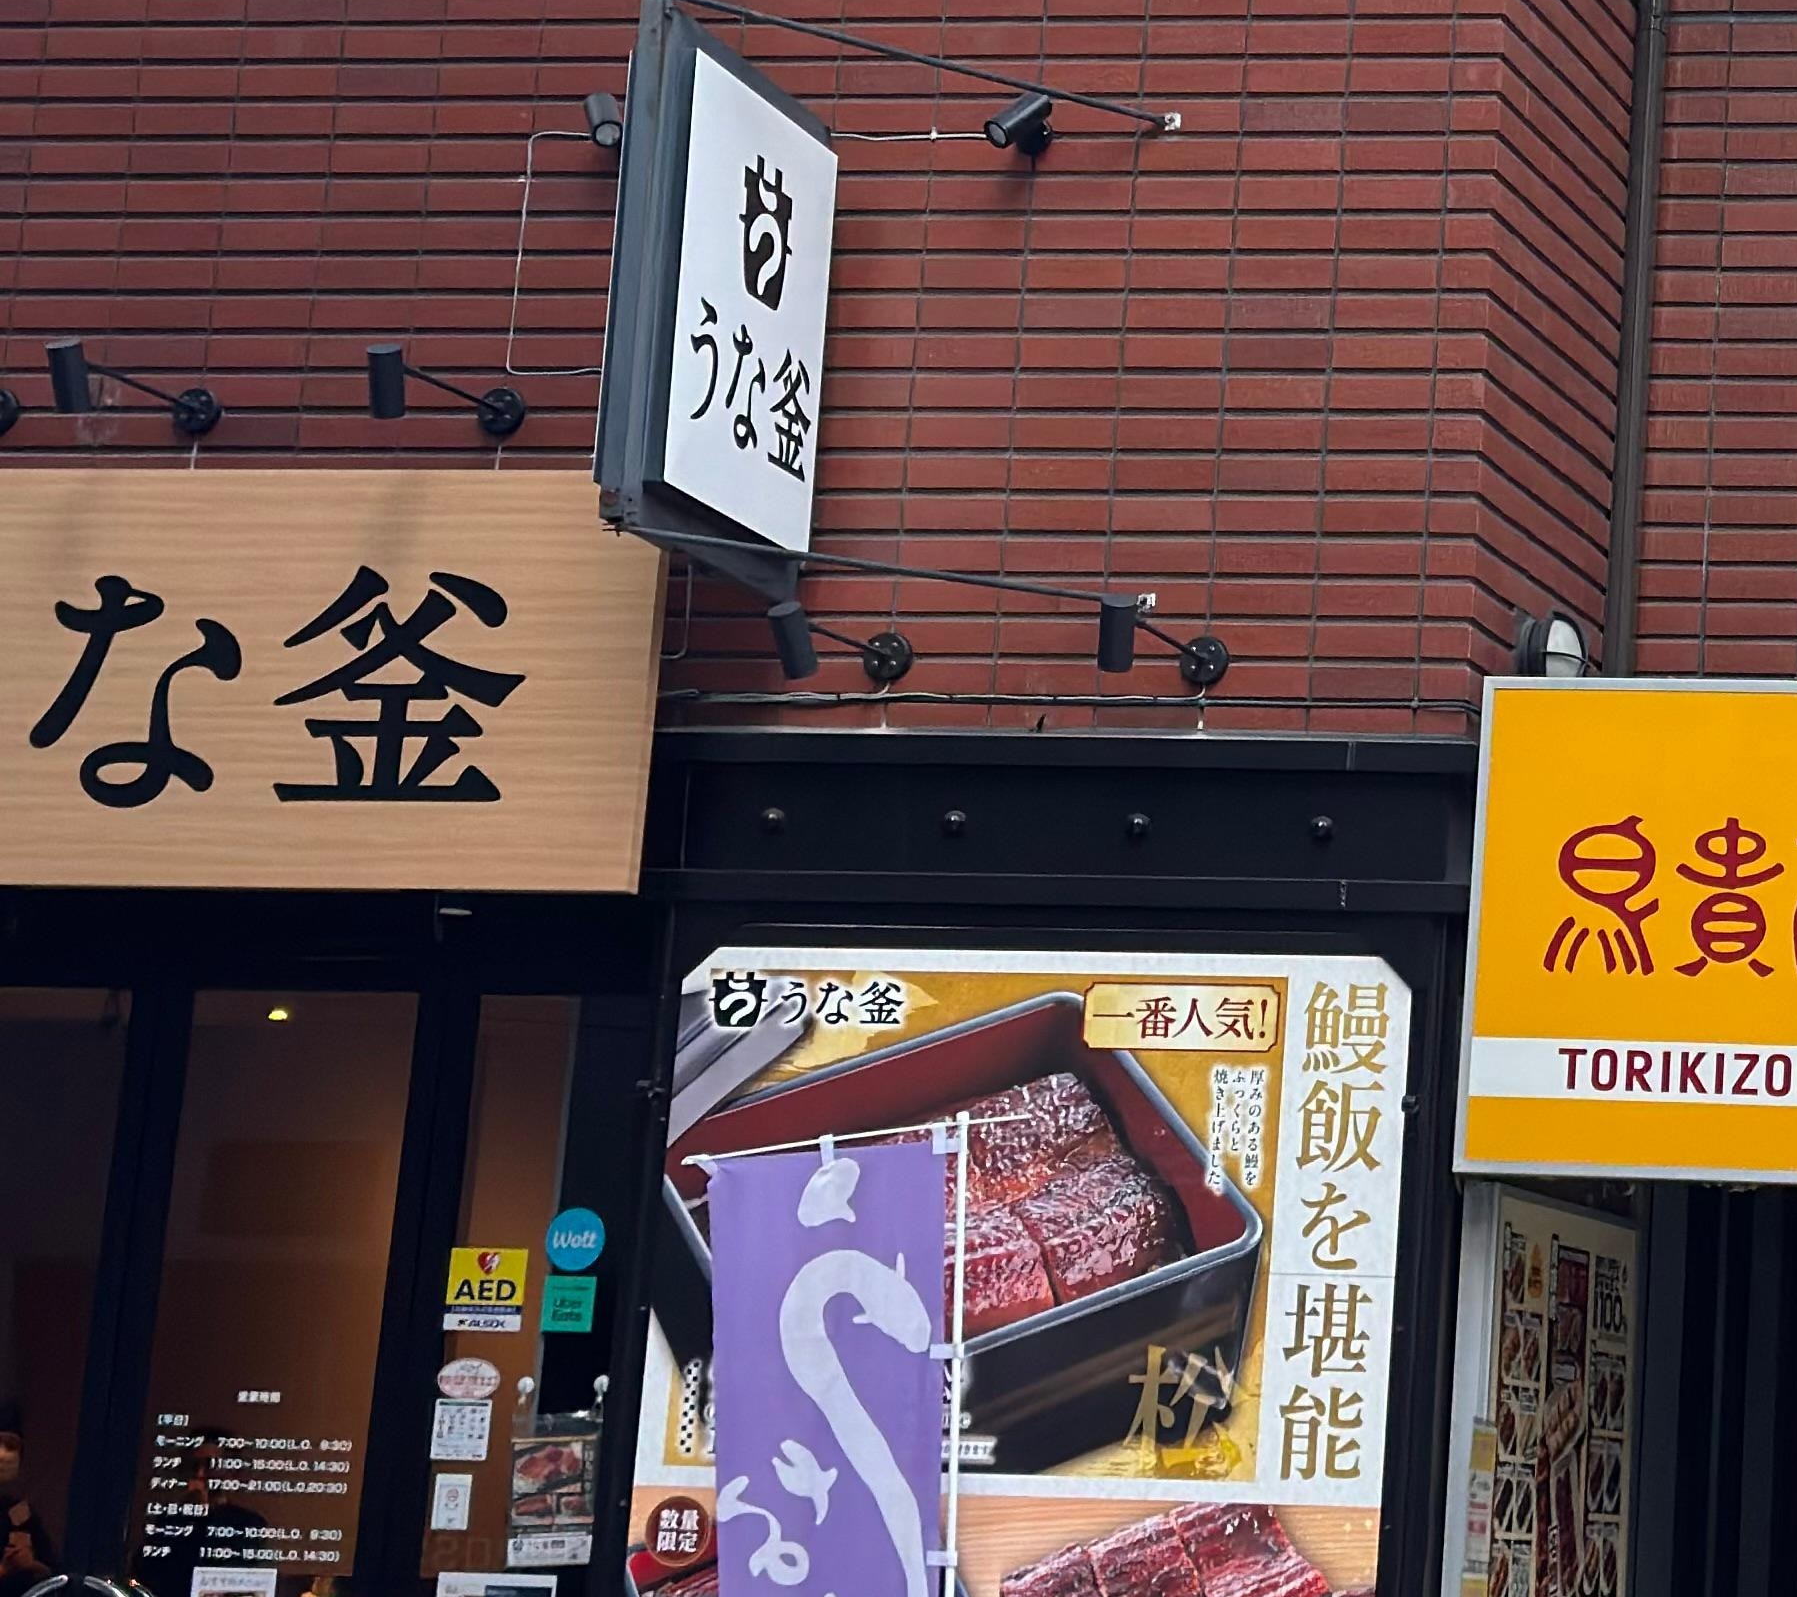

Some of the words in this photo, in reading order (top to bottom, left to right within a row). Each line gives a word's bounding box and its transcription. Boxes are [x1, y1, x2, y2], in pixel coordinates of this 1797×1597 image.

[690, 295, 812, 484] うな釜
[29, 564, 526, 808] な釜
[781, 981, 905, 1025] うな釜
[1092, 996, 1268, 1040] 一番人気!
[1230, 1069, 1247, 1153] ふっくらと
[1207, 1069, 1229, 1186] 焼き上げました
[1243, 1069, 1265, 1186] 厚みのある鰻を
[552, 1231, 597, 1249] Wolt
[1279, 980, 1389, 1482] 鰻飯を堪能
[454, 1279, 517, 1301] AED
[237, 1391, 281, 1403] 営業時間
[155, 1435, 205, 1448] モーニング
[152, 1456, 182, 1468] ランチ
[150, 1477, 187, 1489] ディナー
[144, 1524, 194, 1537] モーニング
[659, 1509, 700, 1531] 数量
[142, 1545, 172, 1557] ランチ
[656, 1531, 699, 1554] 限定
